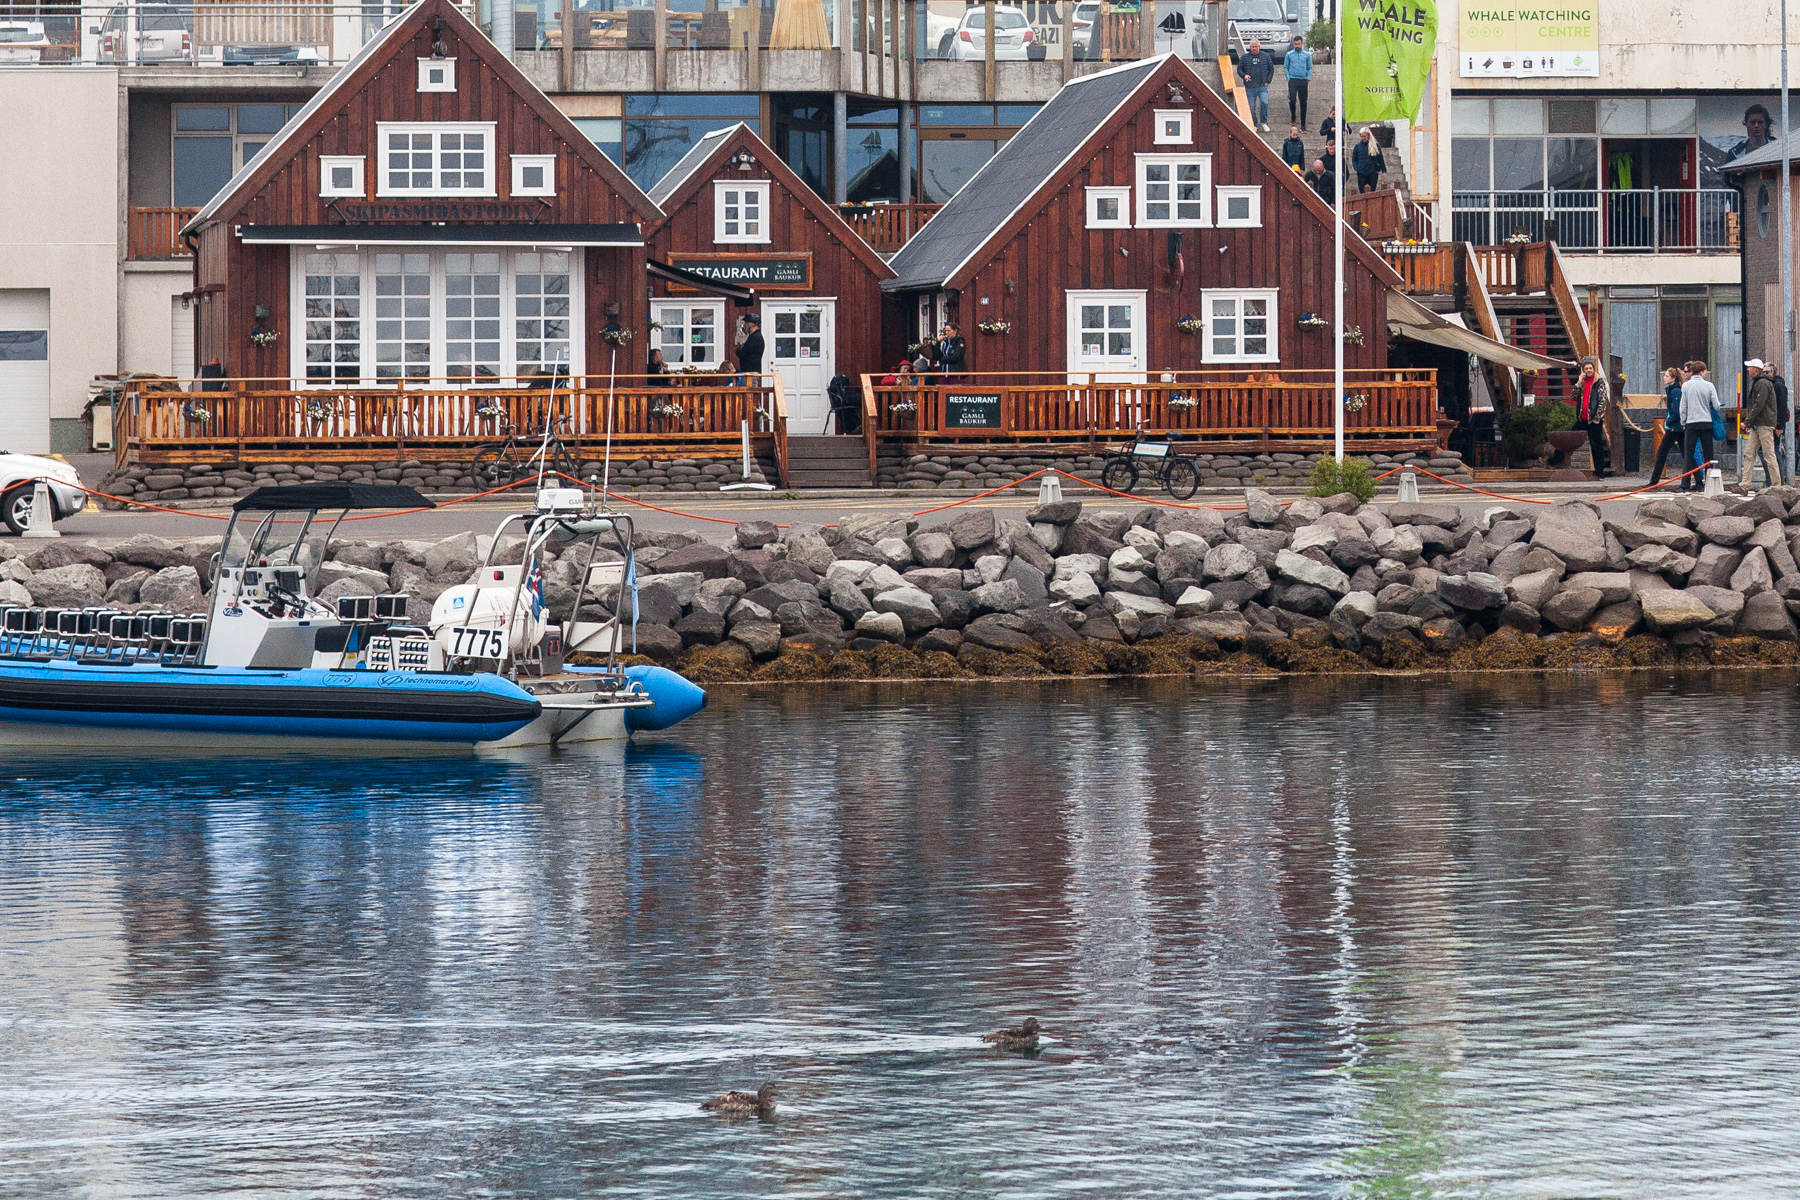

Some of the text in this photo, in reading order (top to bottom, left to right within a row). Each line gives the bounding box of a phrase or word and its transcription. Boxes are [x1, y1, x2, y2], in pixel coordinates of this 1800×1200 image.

[1468, 10, 1591, 21] WHALE WATCHING
[1358, 17, 1424, 45] WATHING
[1538, 26, 1591, 38] CENTRE
[1365, 86, 1396, 94] NORTH
[949, 396, 998, 404] RESTAURANT
[453, 627, 503, 658] 7775
[327, 674, 352, 683] 7775
[404, 677, 476, 687] technomarine.pl
